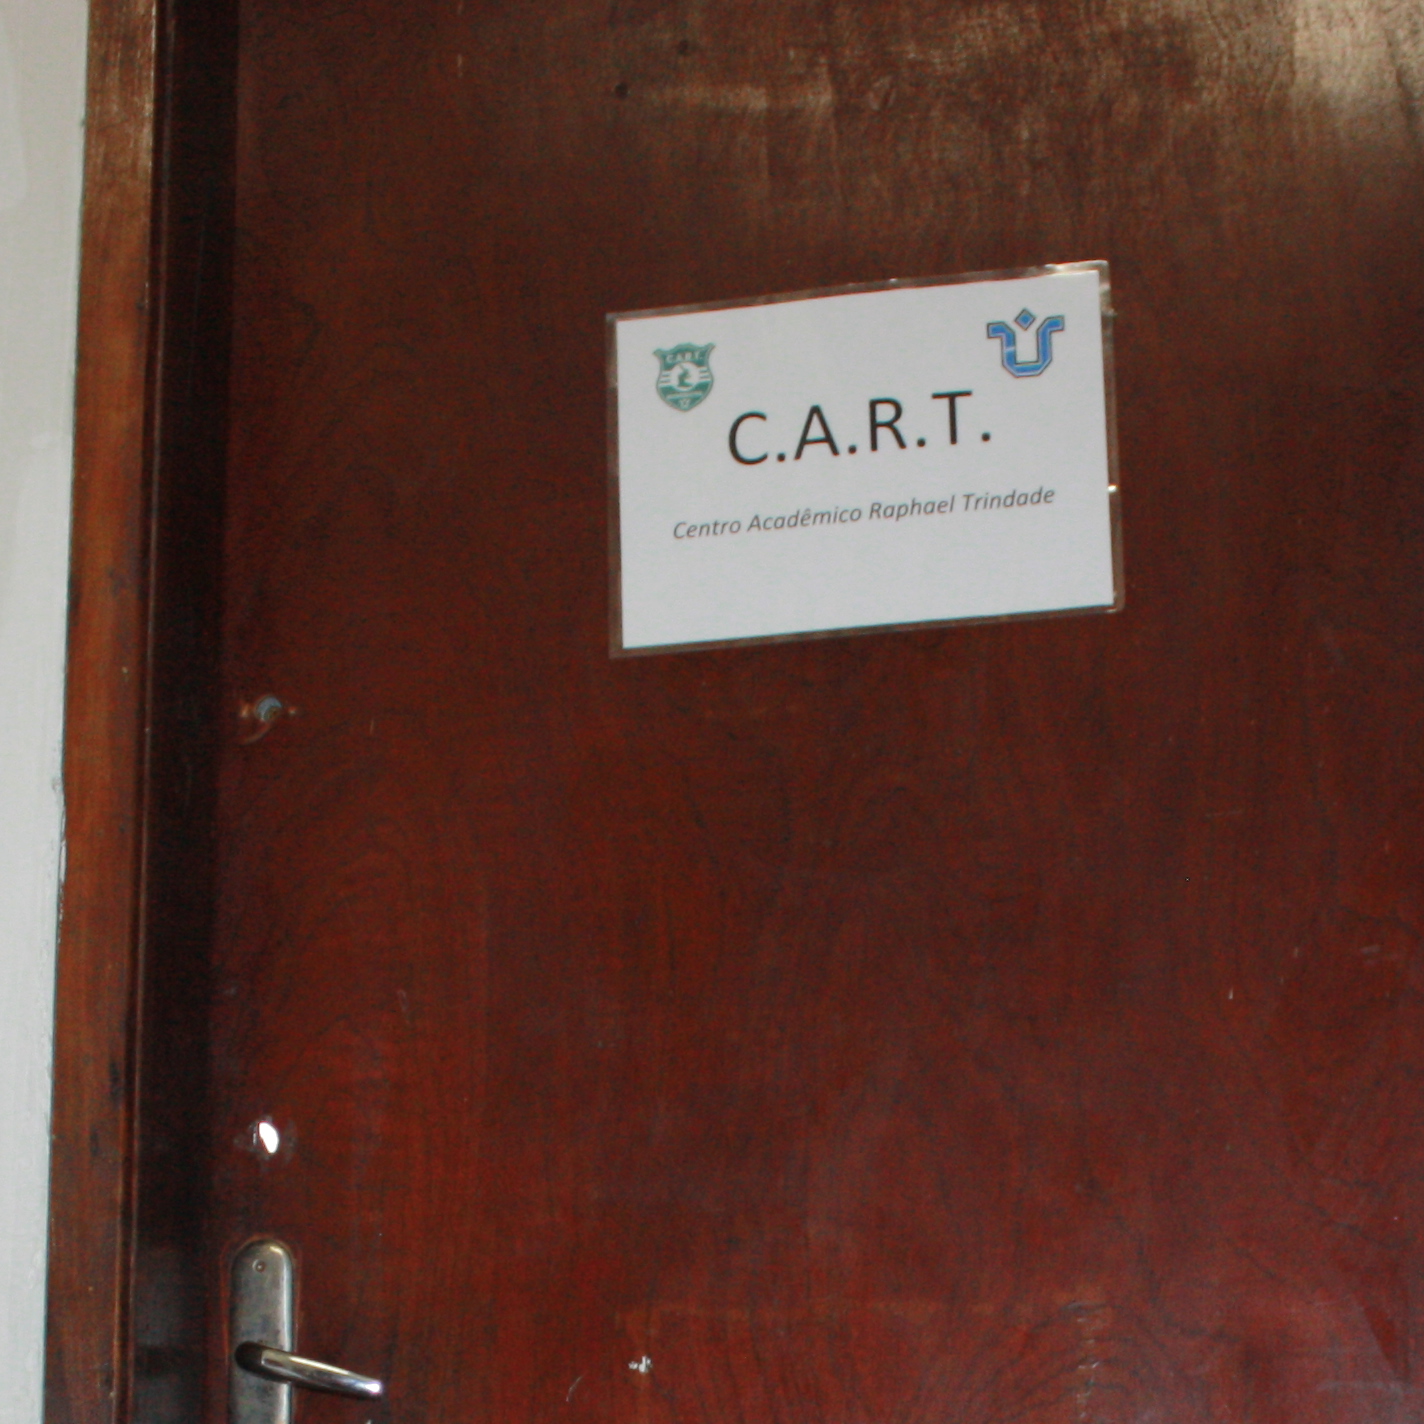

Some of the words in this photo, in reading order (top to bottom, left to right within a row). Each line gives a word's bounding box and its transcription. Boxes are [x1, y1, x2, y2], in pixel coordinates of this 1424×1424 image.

[727, 390, 992, 466] C.A.R.T.
[673, 519, 742, 540] Centro
[747, 507, 862, 533] Acadêmico
[869, 494, 955, 522] Raphael
[962, 485, 1056, 512] Trindade
